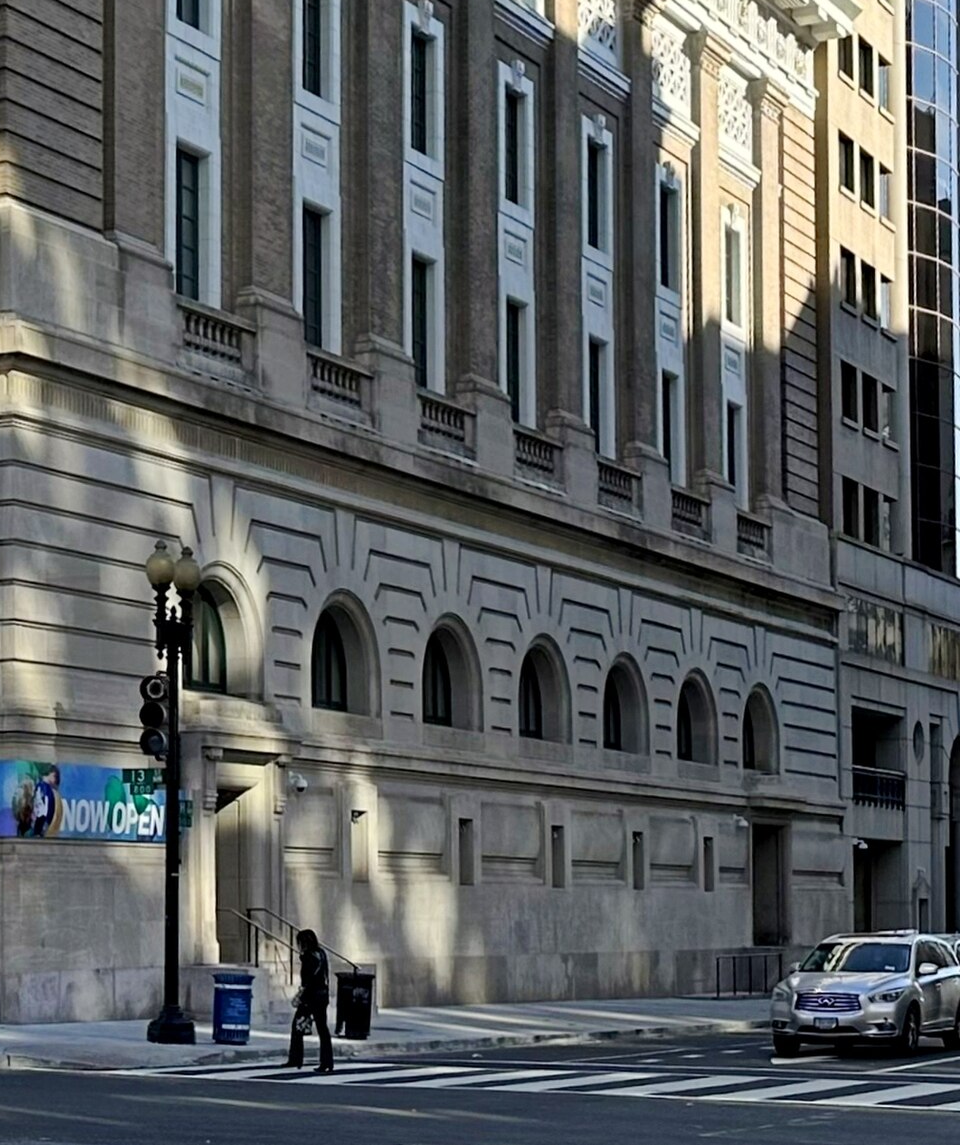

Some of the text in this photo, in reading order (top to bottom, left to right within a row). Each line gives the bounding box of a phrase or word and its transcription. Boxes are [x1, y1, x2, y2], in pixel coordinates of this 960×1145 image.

[132, 770, 145, 782] 13
[61, 798, 165, 837] NOW OPEN
